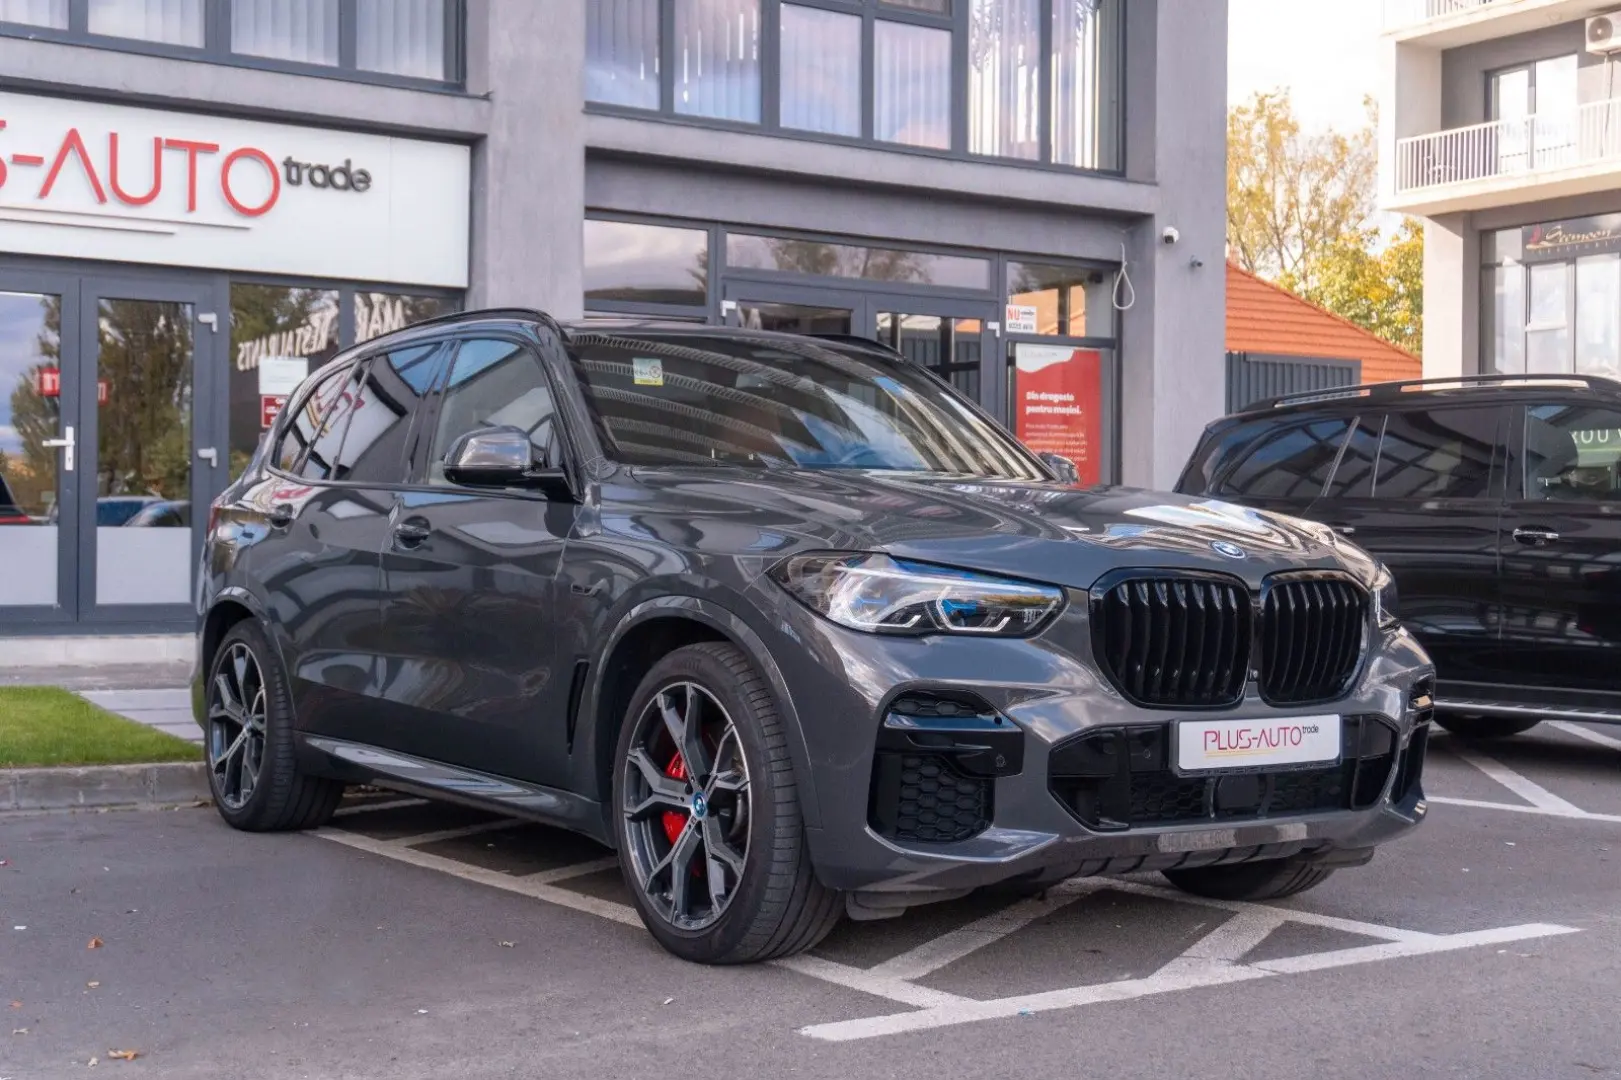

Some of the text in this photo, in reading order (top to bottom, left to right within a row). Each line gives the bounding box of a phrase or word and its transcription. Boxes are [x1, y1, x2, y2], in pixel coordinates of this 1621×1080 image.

[0, 119, 372, 217] -AUTO trade
[1007, 307, 1021, 320] NU
[1203, 724, 1319, 751] PLUS-AUTO trade
